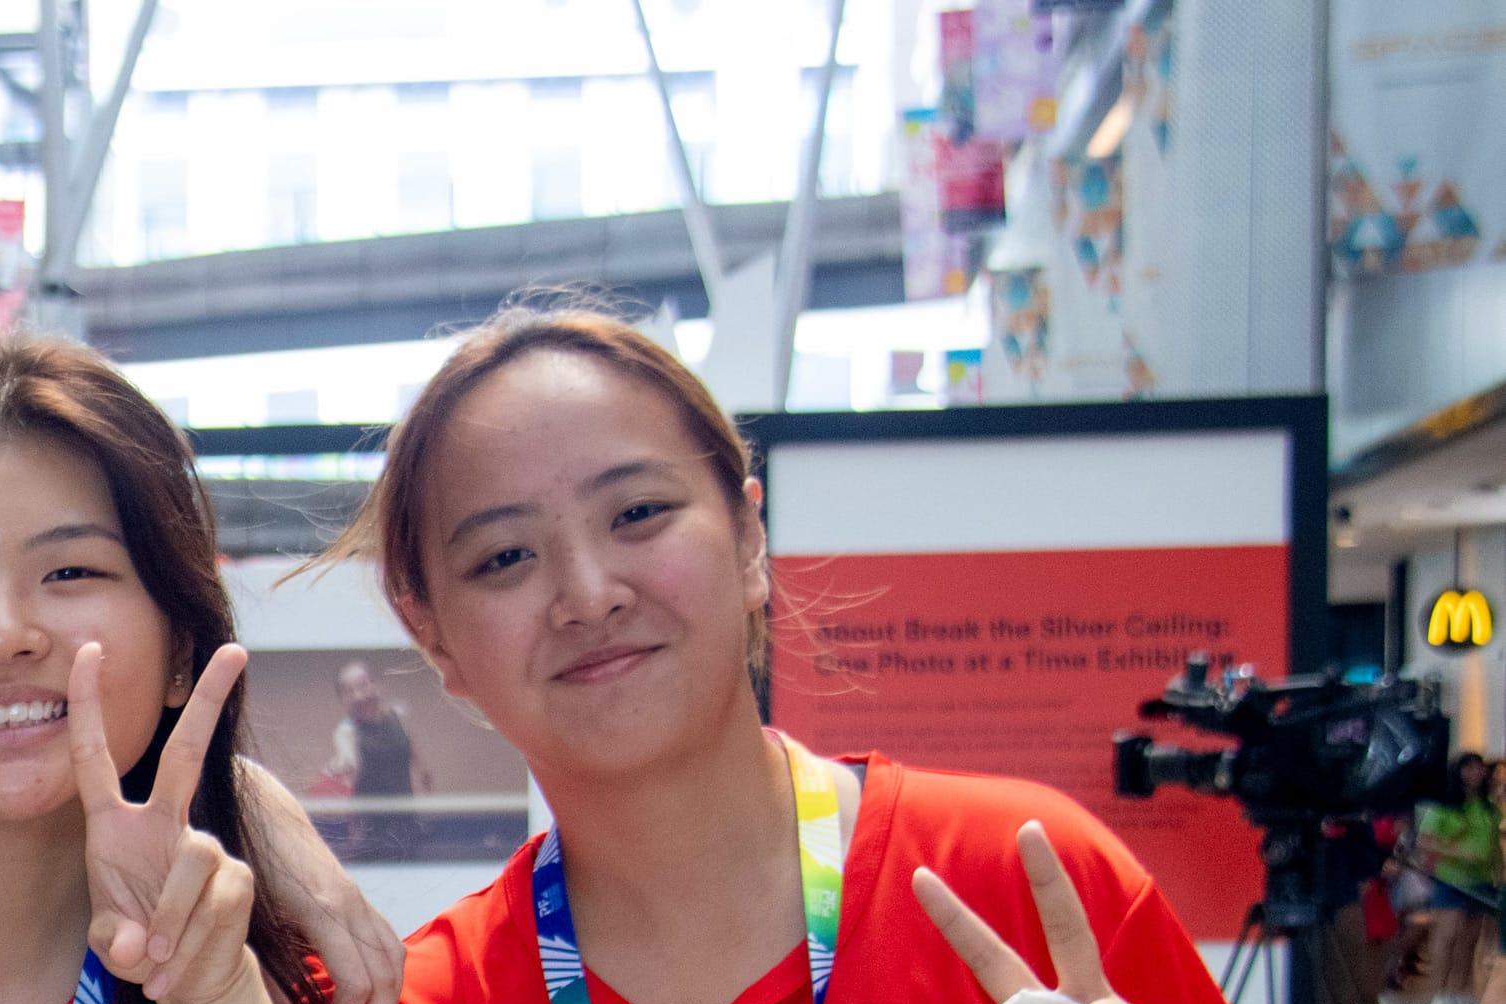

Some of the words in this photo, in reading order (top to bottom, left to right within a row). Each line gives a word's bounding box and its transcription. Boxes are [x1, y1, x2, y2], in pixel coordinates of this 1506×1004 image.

[905, 619, 978, 641] Break
[990, 618, 1030, 640] the
[1040, 614, 1115, 639] Silver
[1125, 611, 1229, 639] Ceiling:
[878, 651, 955, 673] Photo
[965, 654, 990, 671] at
[1024, 647, 1087, 671] Time
